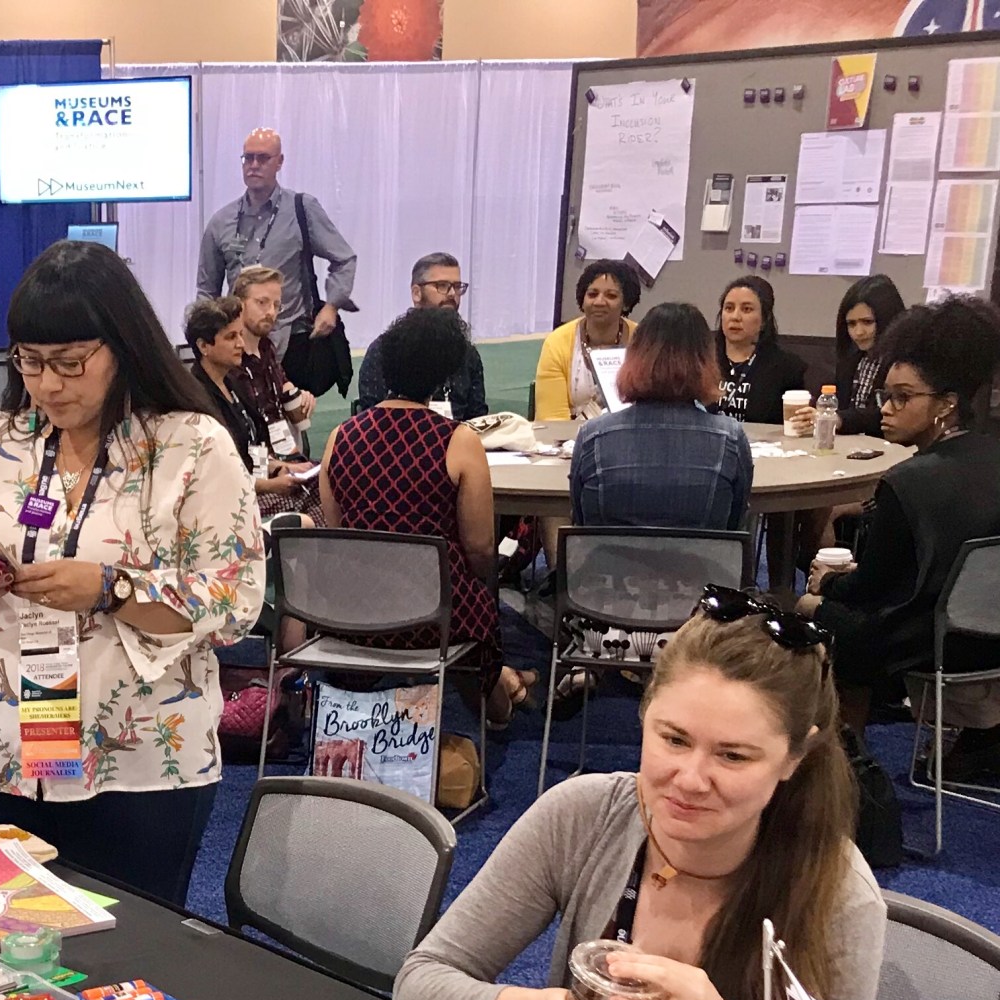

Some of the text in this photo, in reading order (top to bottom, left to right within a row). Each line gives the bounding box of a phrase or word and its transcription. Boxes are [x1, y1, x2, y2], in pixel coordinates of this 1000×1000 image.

[54, 96, 132, 109] MUSEUMS
[55, 109, 132, 127] &RACE
[65, 179, 145, 192] MuseumNext
[26, 663, 45, 673] 2018
[320, 695, 360, 712] From the
[324, 702, 413, 737] Brooklyn
[24, 727, 76, 736] PRESENTER
[371, 722, 436, 755] Bridge
[26, 761, 53, 769] SOCIAL
[30, 769, 77, 777] JOURNALIST
